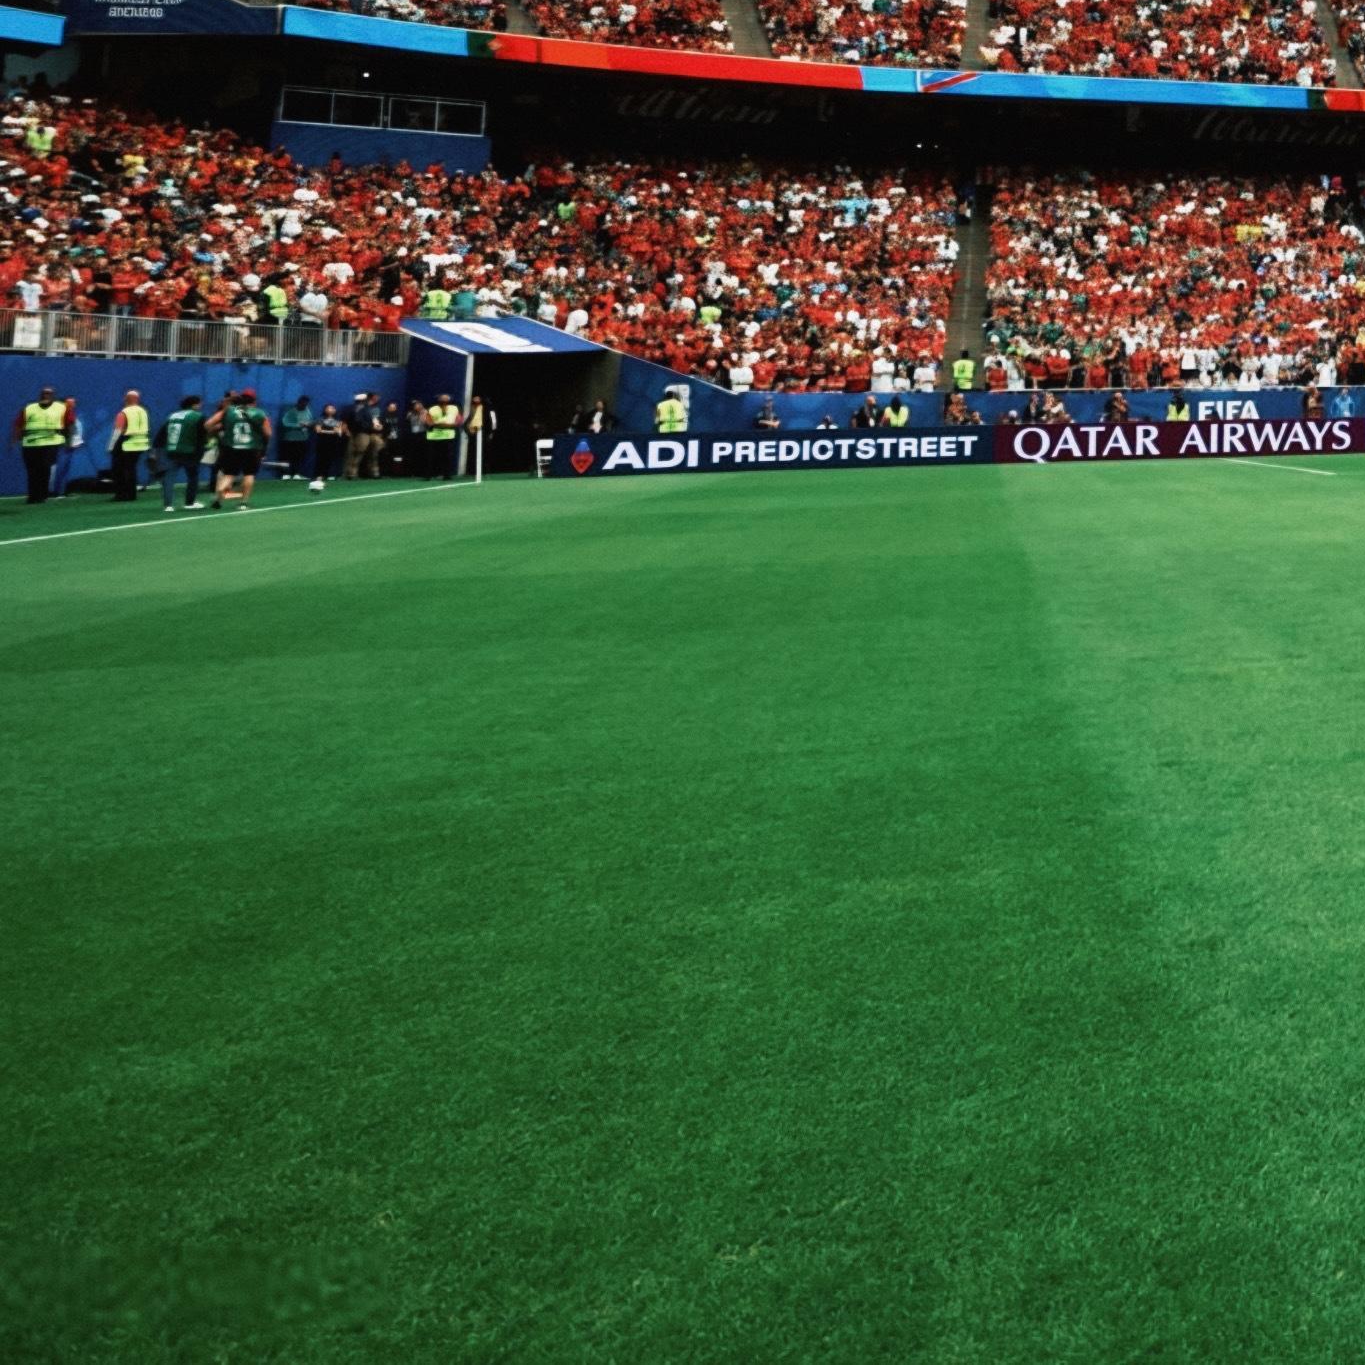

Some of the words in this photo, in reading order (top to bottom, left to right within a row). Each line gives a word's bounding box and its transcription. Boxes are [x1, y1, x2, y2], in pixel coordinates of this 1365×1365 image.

[1198, 400, 1261, 421] FIFA
[602, 439, 699, 469] ADI
[711, 435, 979, 464] PREDICTSTREET
[1013, 425, 1161, 464] QATAR
[1178, 421, 1352, 454] AIRWAYS
